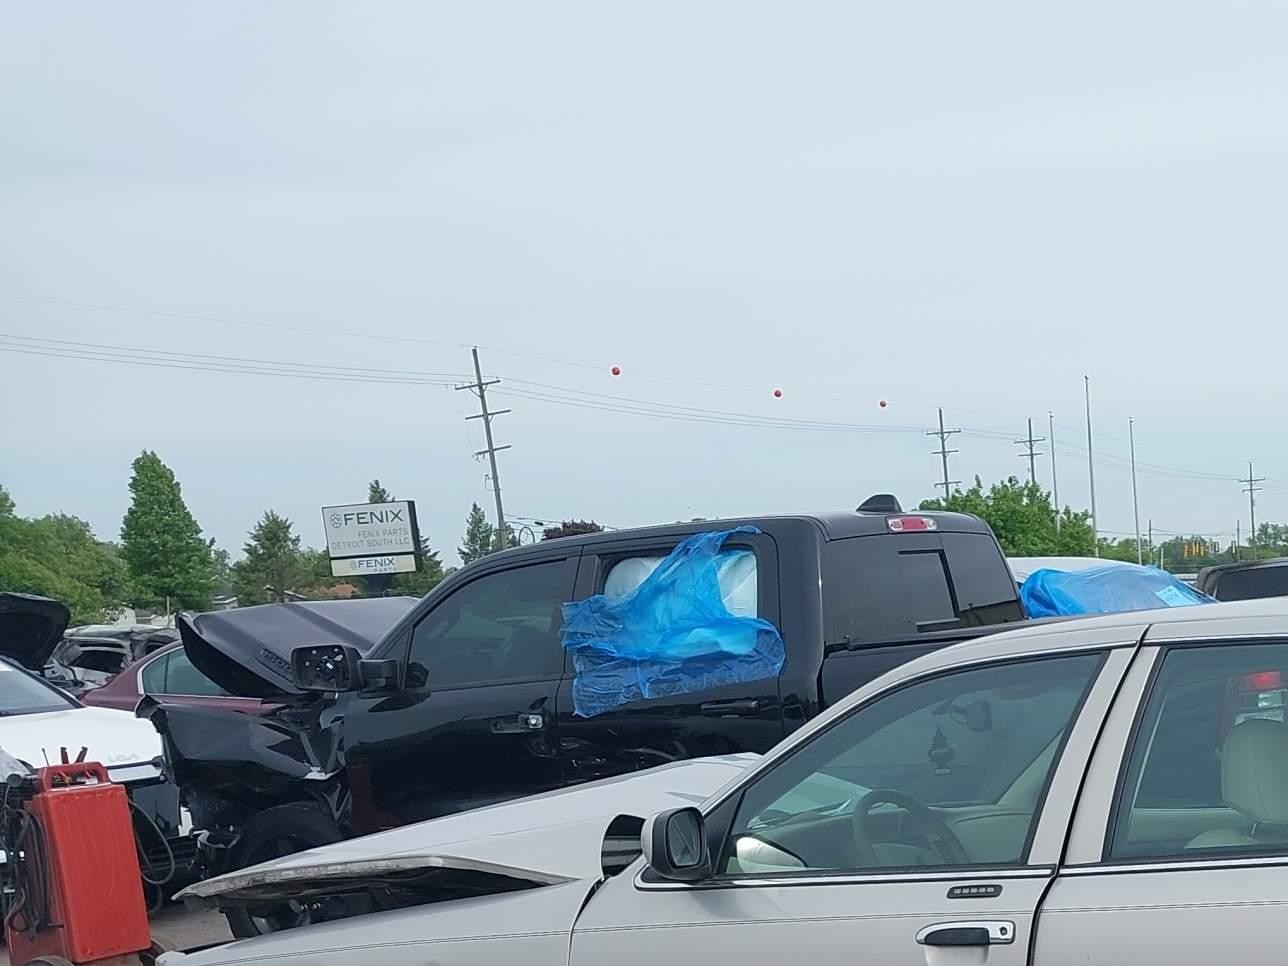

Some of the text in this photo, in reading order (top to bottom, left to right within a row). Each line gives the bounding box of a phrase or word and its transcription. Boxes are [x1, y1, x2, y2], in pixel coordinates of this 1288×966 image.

[343, 509, 404, 526] FENIX
[358, 528, 409, 539] FENIX PARTS
[331, 537, 410, 551] DETROIT SOUTH LLC
[358, 557, 396, 569] FENIX
